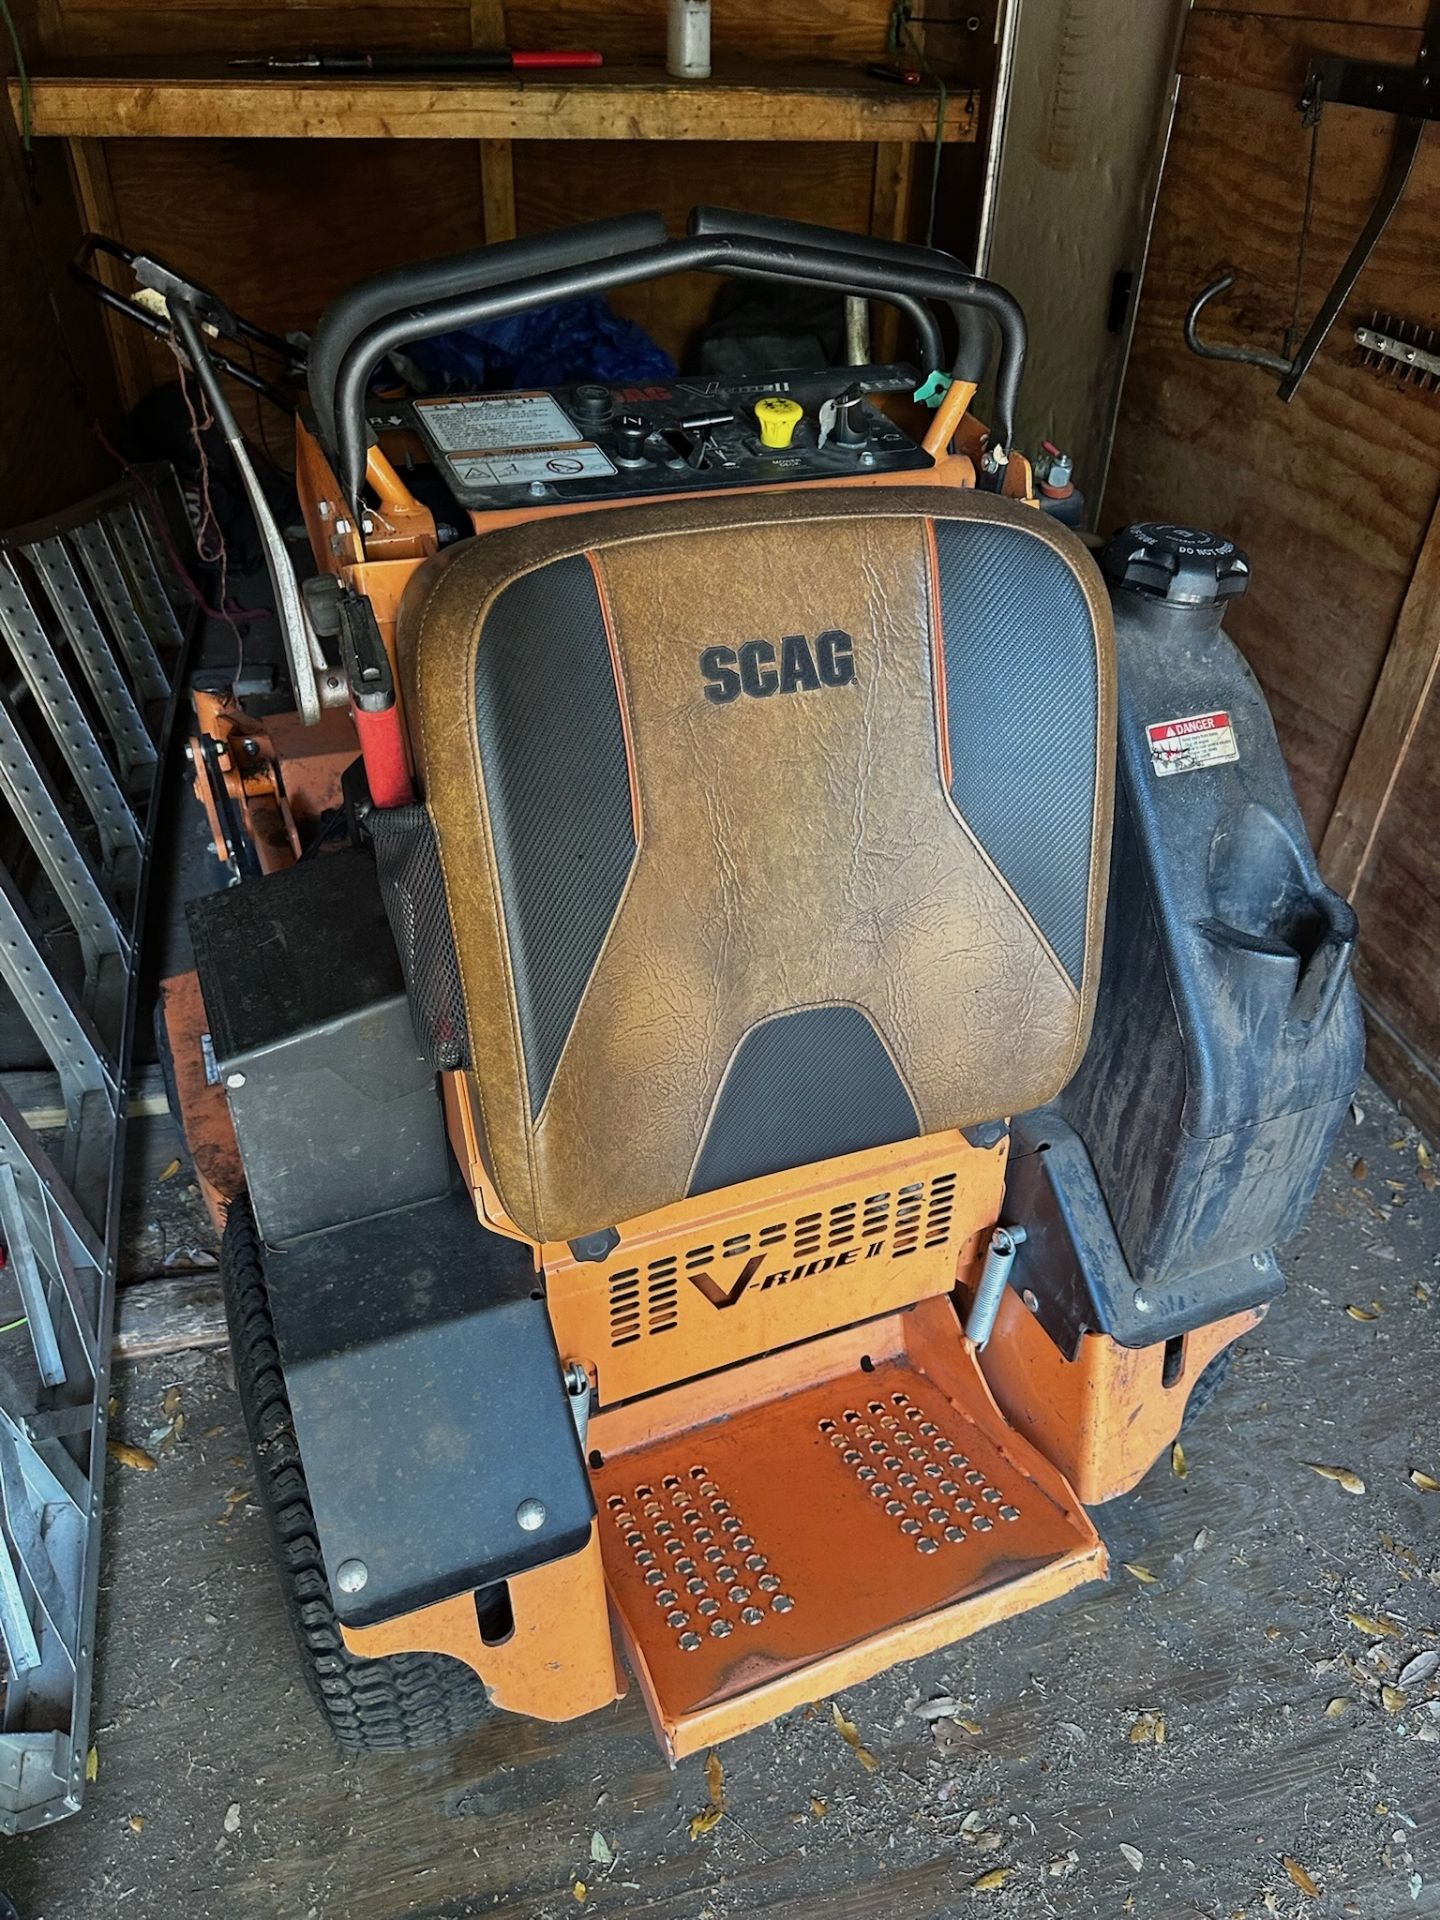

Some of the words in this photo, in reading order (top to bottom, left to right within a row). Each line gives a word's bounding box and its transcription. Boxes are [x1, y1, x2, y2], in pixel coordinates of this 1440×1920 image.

[1178, 546, 1195, 555] DO
[1196, 548, 1217, 556] NOT
[699, 629, 856, 705] SCAG
[1175, 717, 1216, 736] DANGER
[687, 1247, 863, 1311] V-RIDE
[865, 1240, 886, 1259] II
